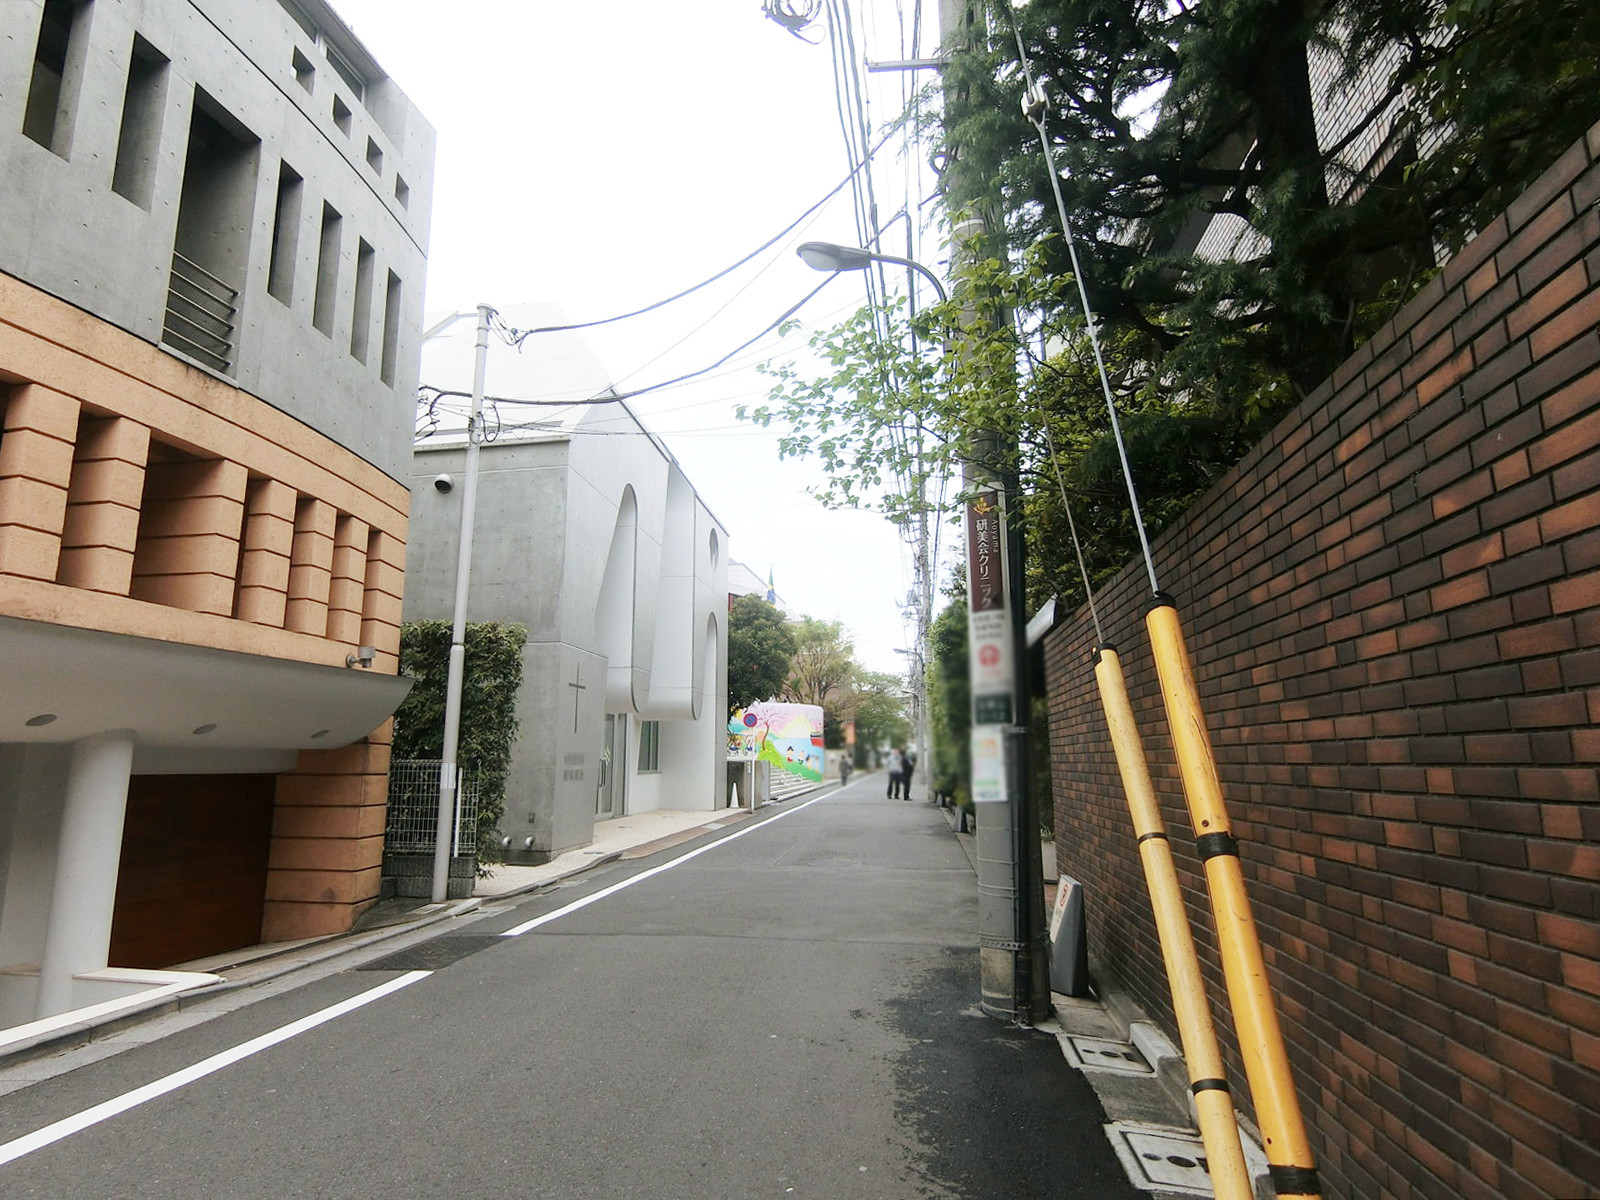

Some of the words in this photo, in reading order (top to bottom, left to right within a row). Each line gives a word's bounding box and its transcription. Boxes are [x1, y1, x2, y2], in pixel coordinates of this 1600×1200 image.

[976, 518, 992, 609] 研美会クリニック
[990, 519, 999, 553] Aoyama
